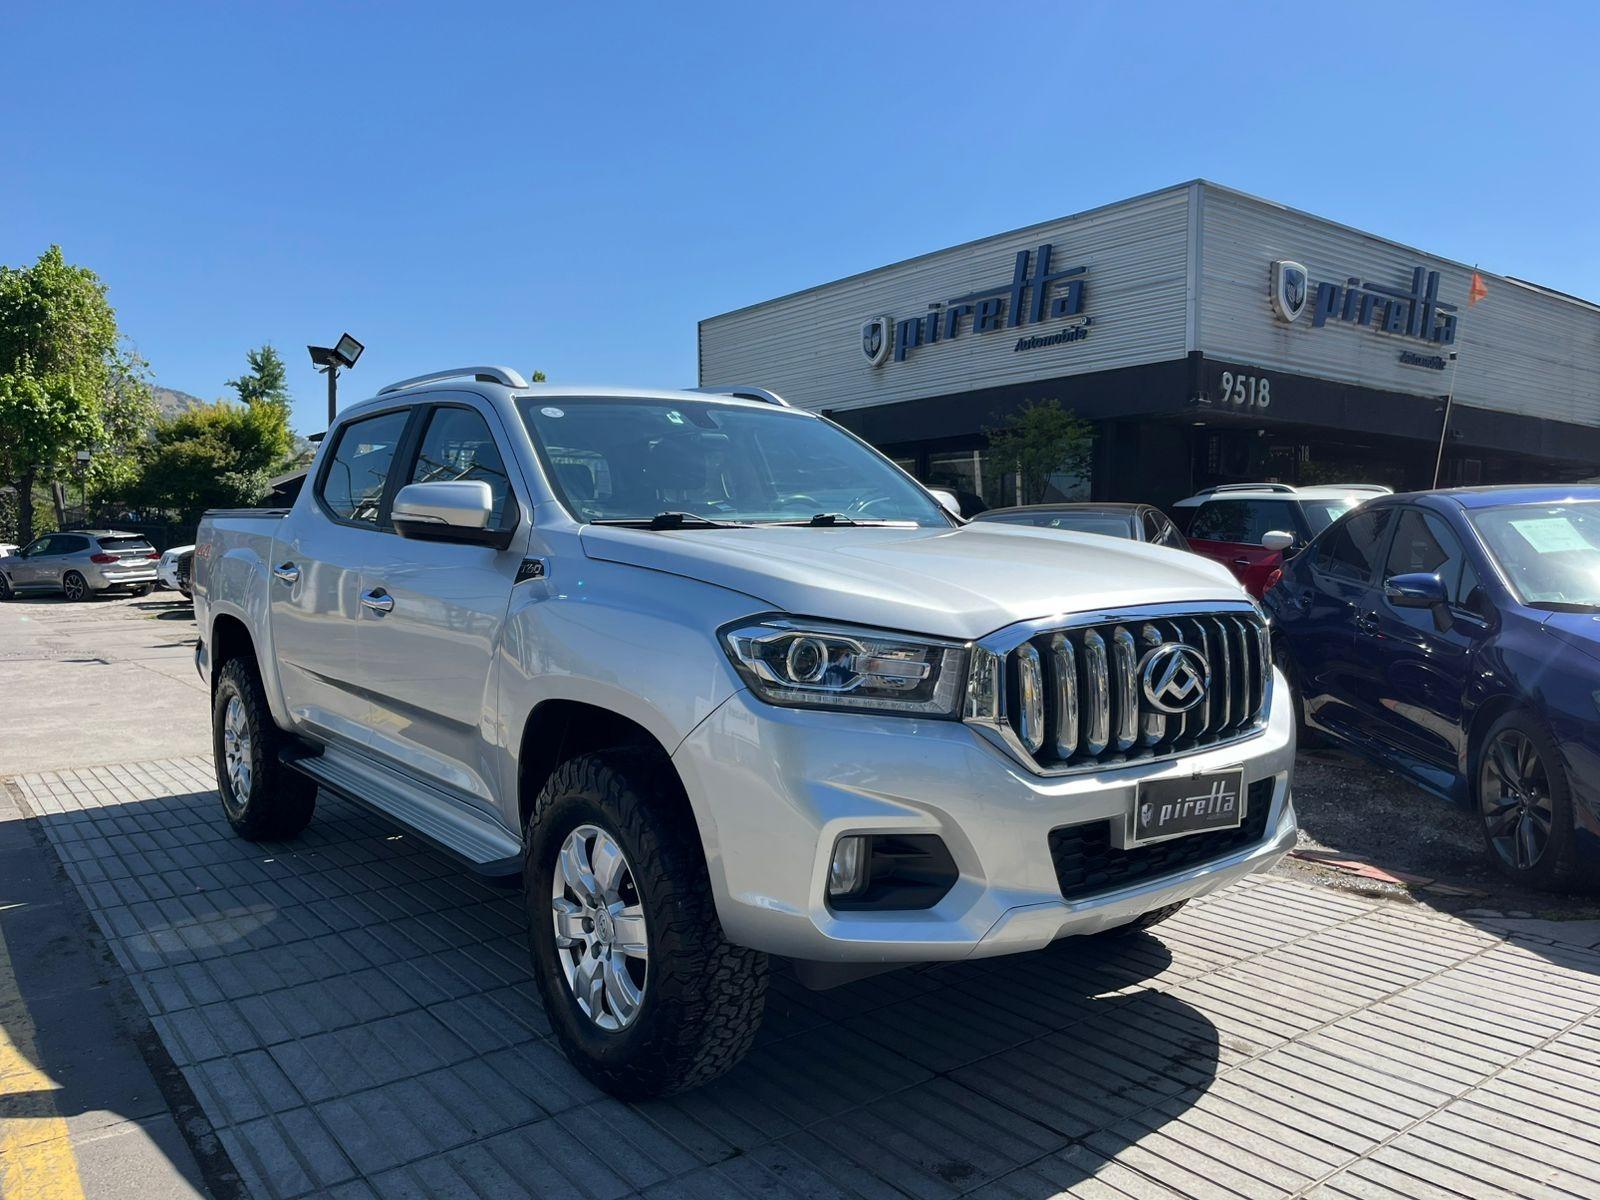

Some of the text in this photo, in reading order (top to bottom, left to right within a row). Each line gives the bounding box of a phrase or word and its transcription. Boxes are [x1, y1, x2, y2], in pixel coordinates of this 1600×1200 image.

[894, 244, 1087, 362] piretta
[1221, 370, 1271, 408] 9518
[1158, 781, 1236, 826] piretta
